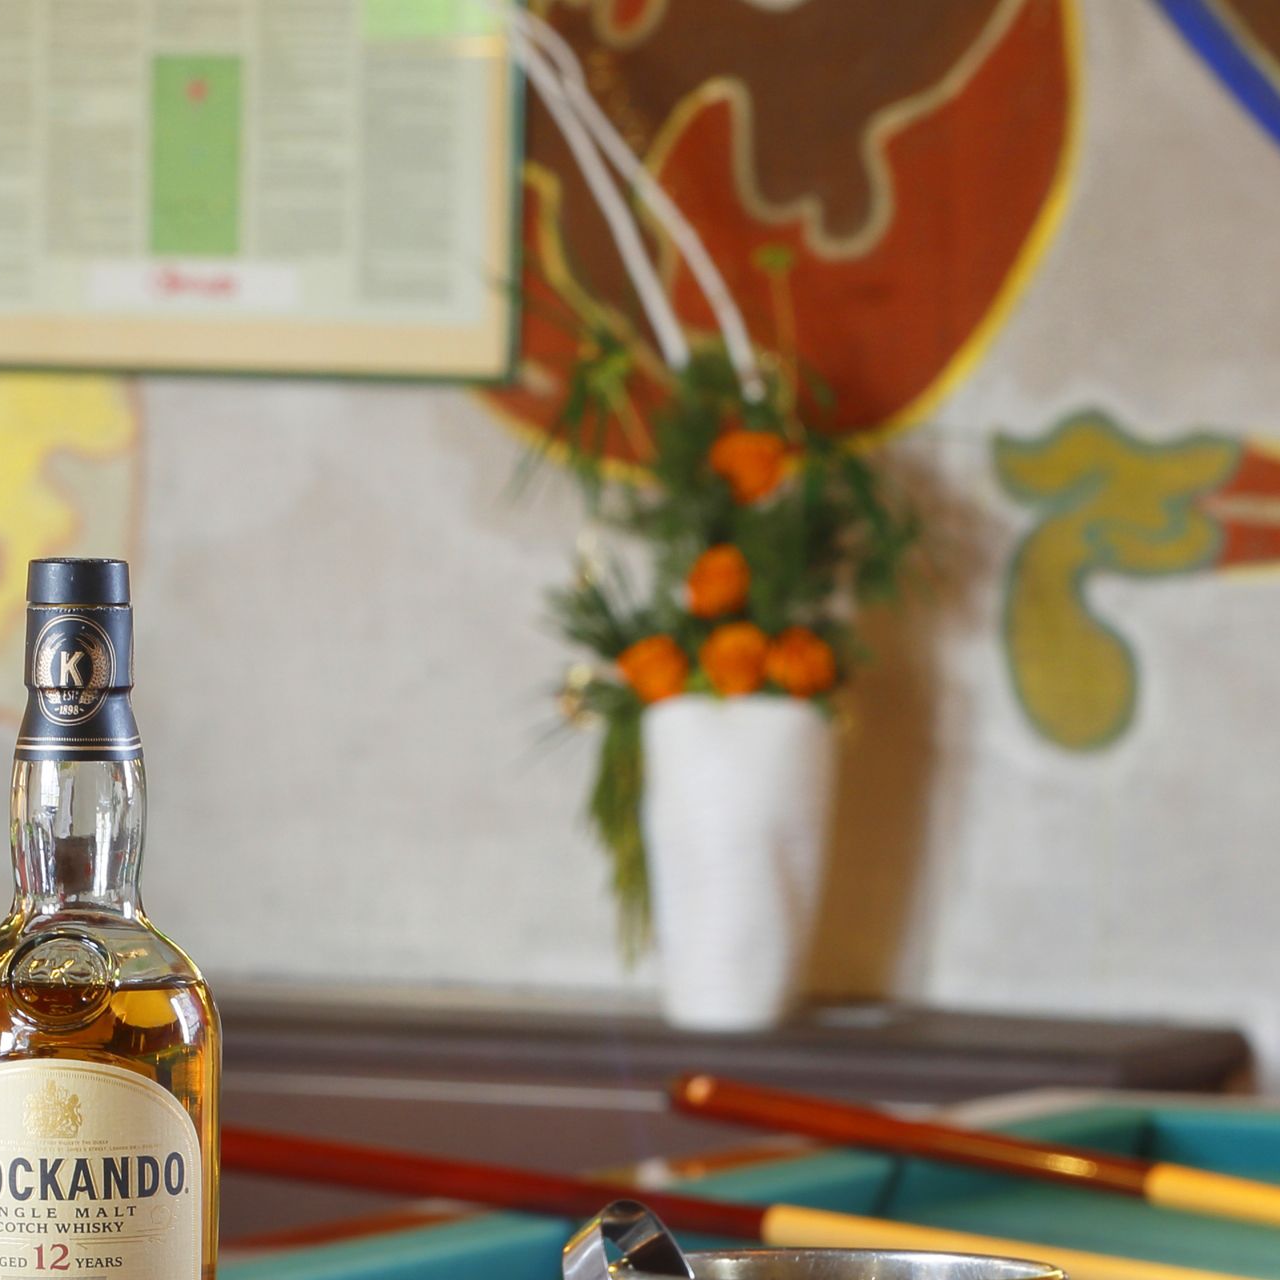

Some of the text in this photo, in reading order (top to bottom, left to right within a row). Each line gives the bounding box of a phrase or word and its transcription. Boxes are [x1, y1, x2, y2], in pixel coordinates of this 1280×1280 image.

[60, 651, 85, 688] K
[75, 1205, 137, 1219] MALT
[55, 1221, 125, 1234] WHISKY
[33, 1243, 71, 1271] 12
[75, 1256, 123, 1269] YEARS
